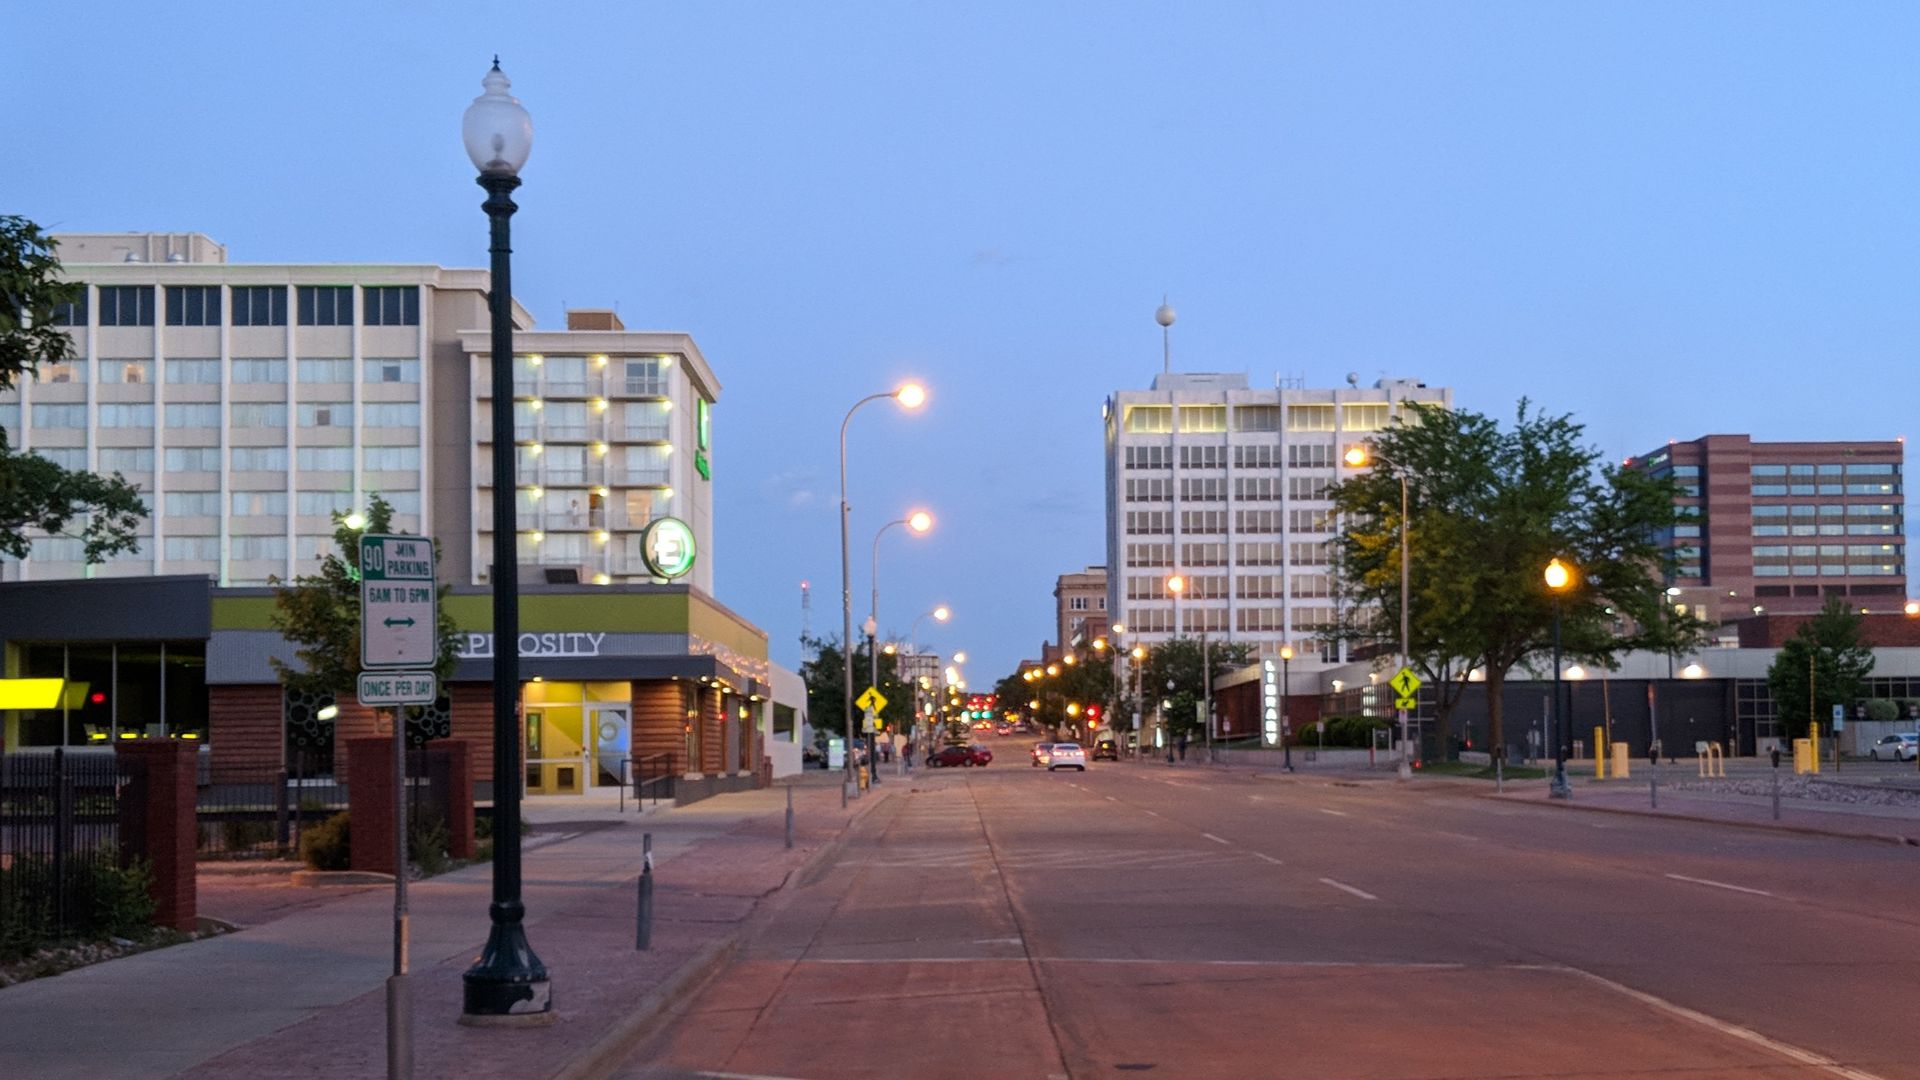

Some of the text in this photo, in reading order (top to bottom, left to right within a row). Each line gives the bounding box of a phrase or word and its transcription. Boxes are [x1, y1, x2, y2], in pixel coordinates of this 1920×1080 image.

[395, 543, 417, 557] MIN
[364, 545, 383, 572] 90
[387, 560, 430, 576] PARKING
[394, 587, 406, 603] TO
[364, 680, 432, 697] ONCE PER DAY
